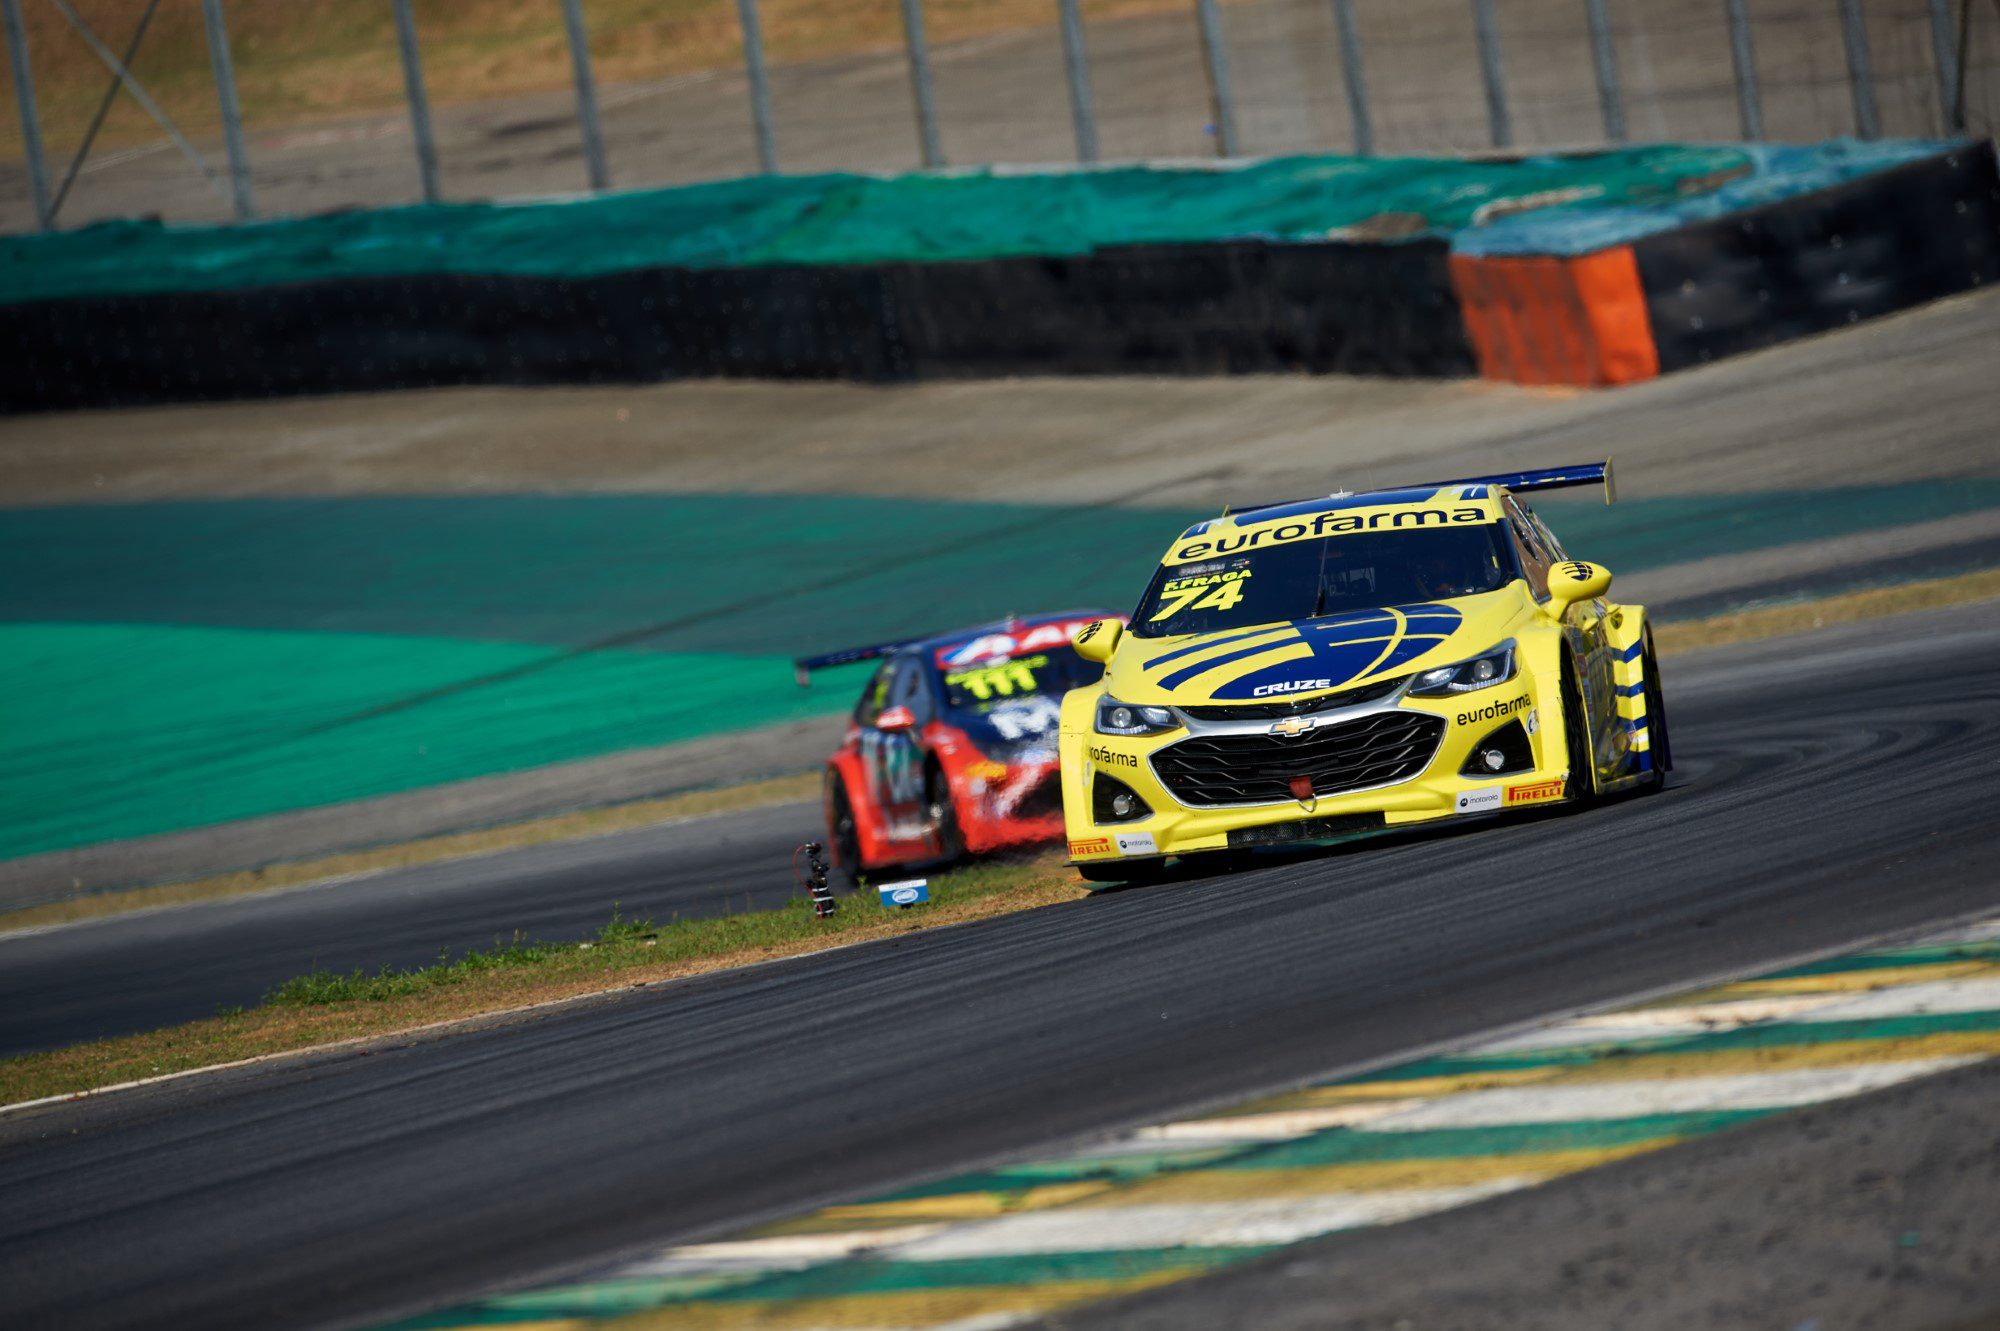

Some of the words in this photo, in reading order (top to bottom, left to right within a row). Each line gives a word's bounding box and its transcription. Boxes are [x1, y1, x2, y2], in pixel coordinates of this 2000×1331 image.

[1178, 507, 1486, 560] eurofarma
[1149, 579, 1244, 622] 74
[1253, 679, 1331, 696] CRUZE
[1457, 693, 1532, 726] eurofarma
[1088, 746, 1138, 768] rofarma
[1508, 780, 1563, 801] PIRELLI
[1067, 838, 1111, 856] PIRELLI
